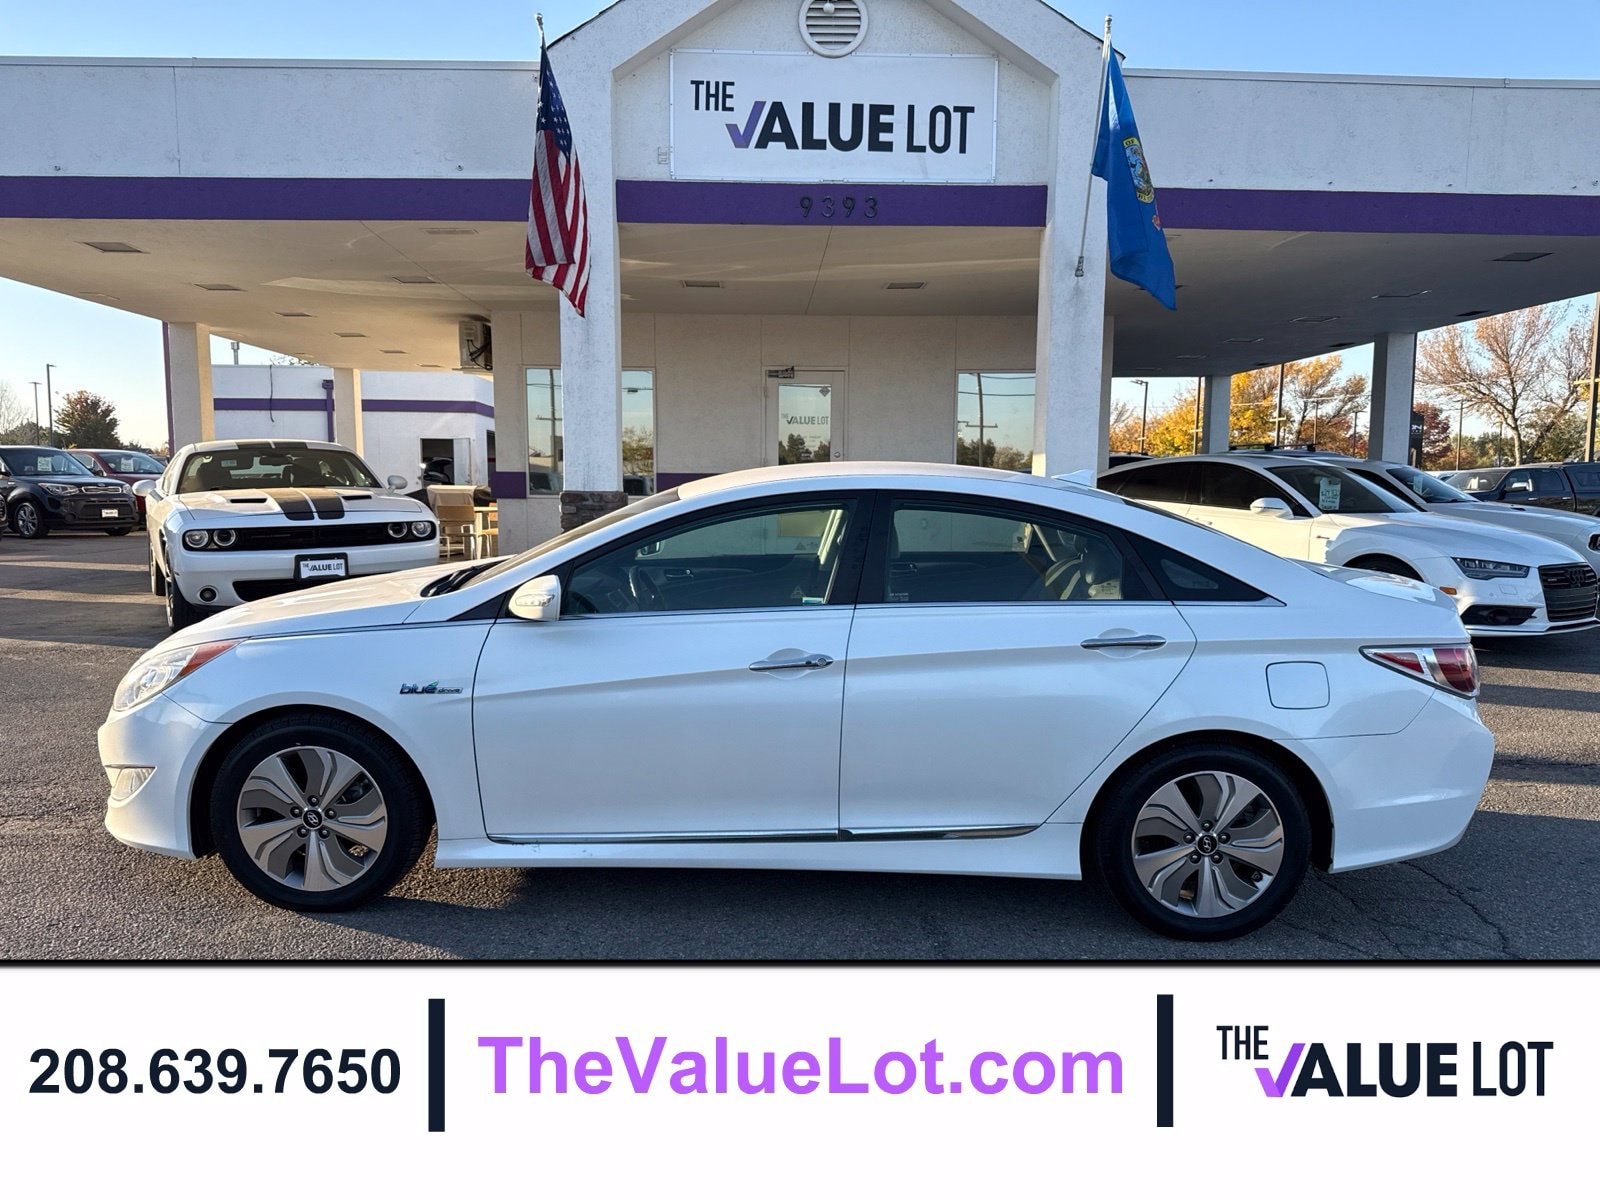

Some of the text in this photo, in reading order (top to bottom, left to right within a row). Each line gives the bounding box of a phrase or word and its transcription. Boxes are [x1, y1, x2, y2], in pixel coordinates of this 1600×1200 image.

[690, 80, 975, 154] THE VALUE LOT
[799, 196, 879, 218] 9393
[786, 416, 816, 425] VALUE
[817, 416, 829, 425] LOT
[309, 564, 332, 572] VALUE
[400, 682, 438, 694] blue
